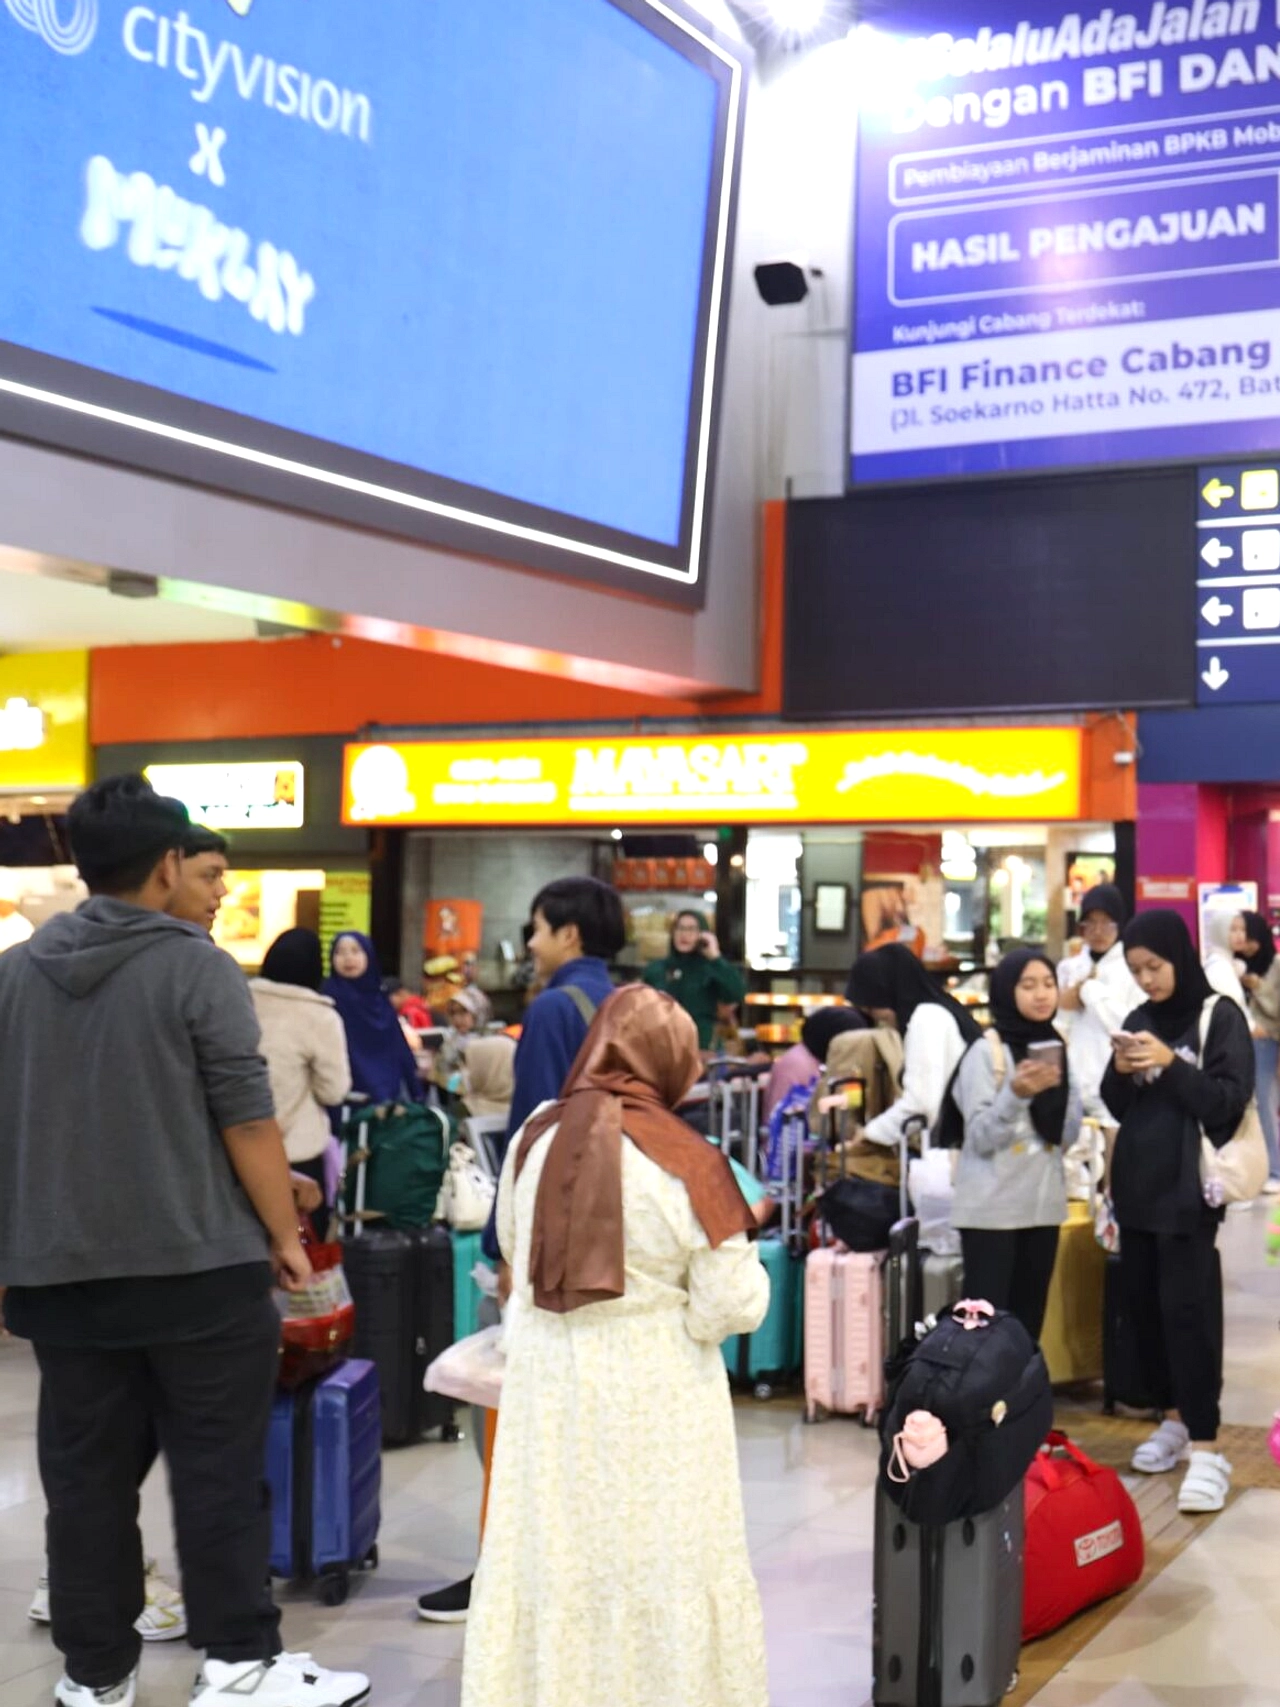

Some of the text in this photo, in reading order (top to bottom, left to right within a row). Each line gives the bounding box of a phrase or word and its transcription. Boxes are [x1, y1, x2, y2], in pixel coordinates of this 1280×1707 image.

[121, 5, 372, 144] cityvision
[1083, 58, 1164, 106] BFI
[903, 154, 1030, 190] Pembiayaan
[1032, 138, 1160, 172] Berjaminan
[1163, 128, 1229, 156] BPKB
[911, 202, 1266, 272] HASIL PENGAJUAN
[892, 369, 948, 398] BFI
[961, 358, 1108, 390] Finance
[1120, 339, 1272, 376] Cabang
[929, 398, 1045, 425] Soekarno
[1051, 391, 1121, 413] Hatta
[1129, 387, 1169, 406] No.
[1177, 378, 1231, 402] 472,
